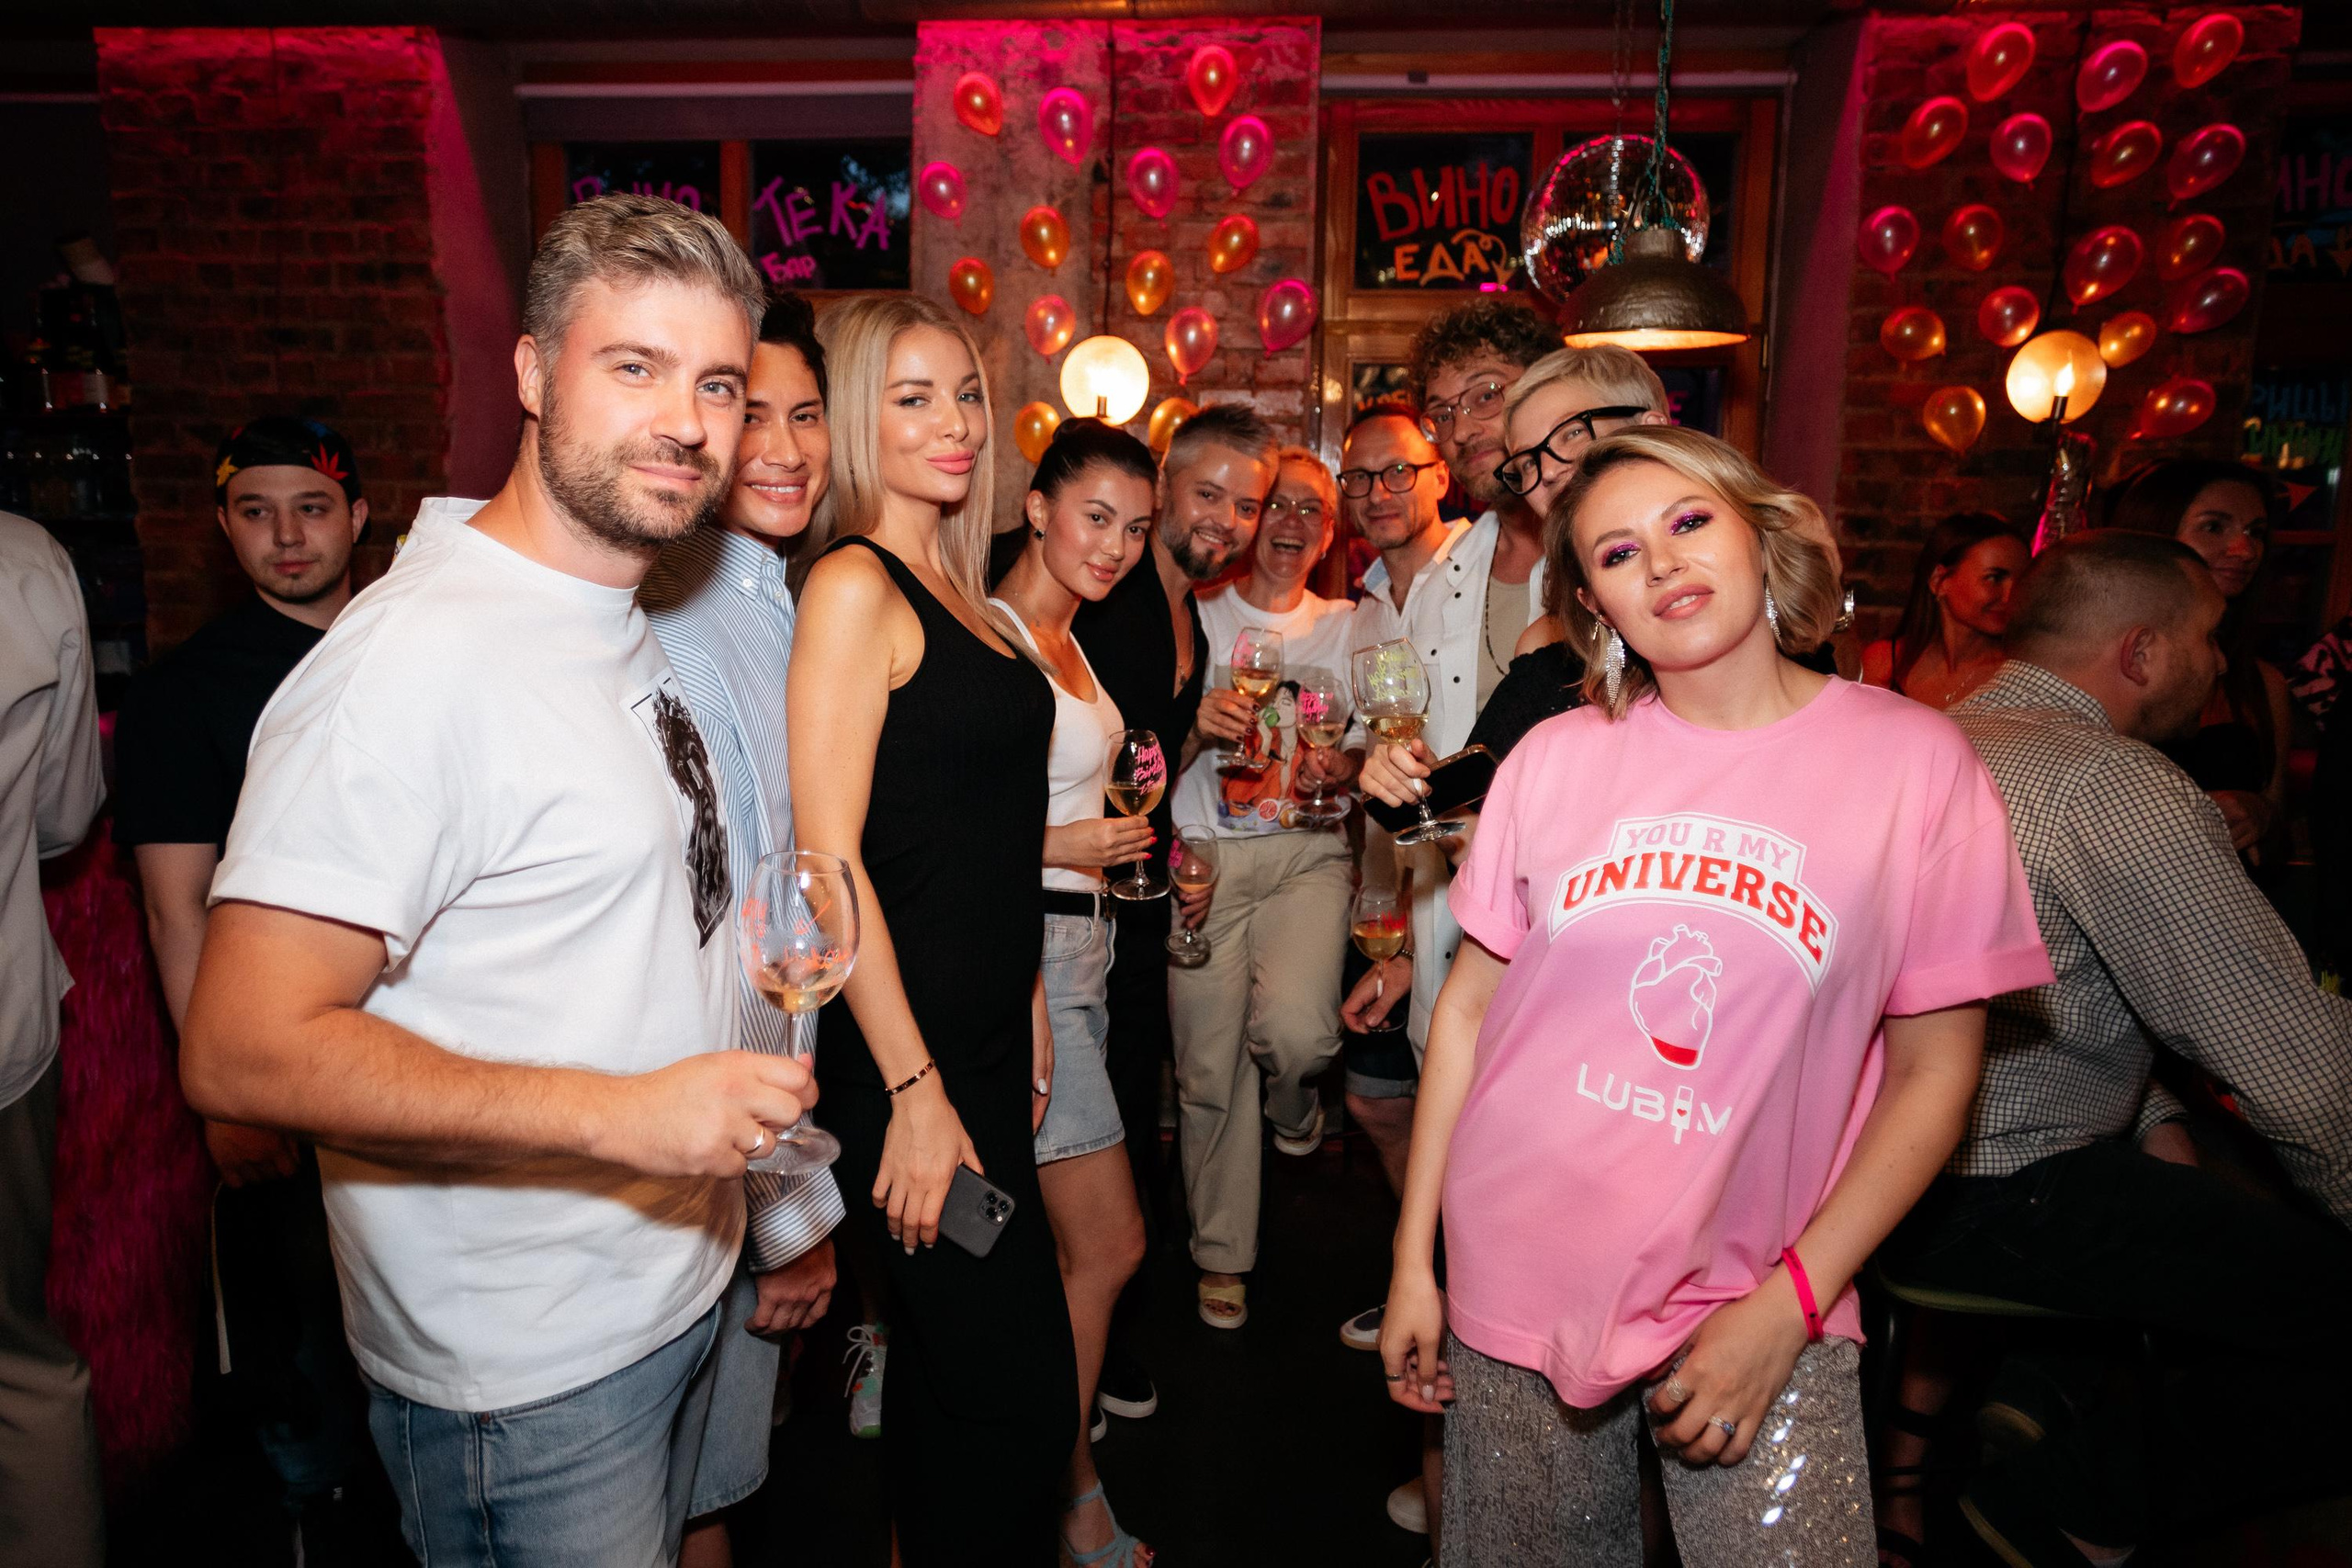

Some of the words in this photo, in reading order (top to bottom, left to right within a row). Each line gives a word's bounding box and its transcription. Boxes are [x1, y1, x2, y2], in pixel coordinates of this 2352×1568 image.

[752, 175, 892, 251] ТЕКА
[1366, 162, 1521, 242] ВИНО
[1393, 241, 1492, 287] ЕДА
[1626, 822, 1693, 849] YOU
[1702, 827, 1726, 852] R
[1736, 832, 1792, 871] MY
[1563, 851, 1827, 965] UNIVERSE
